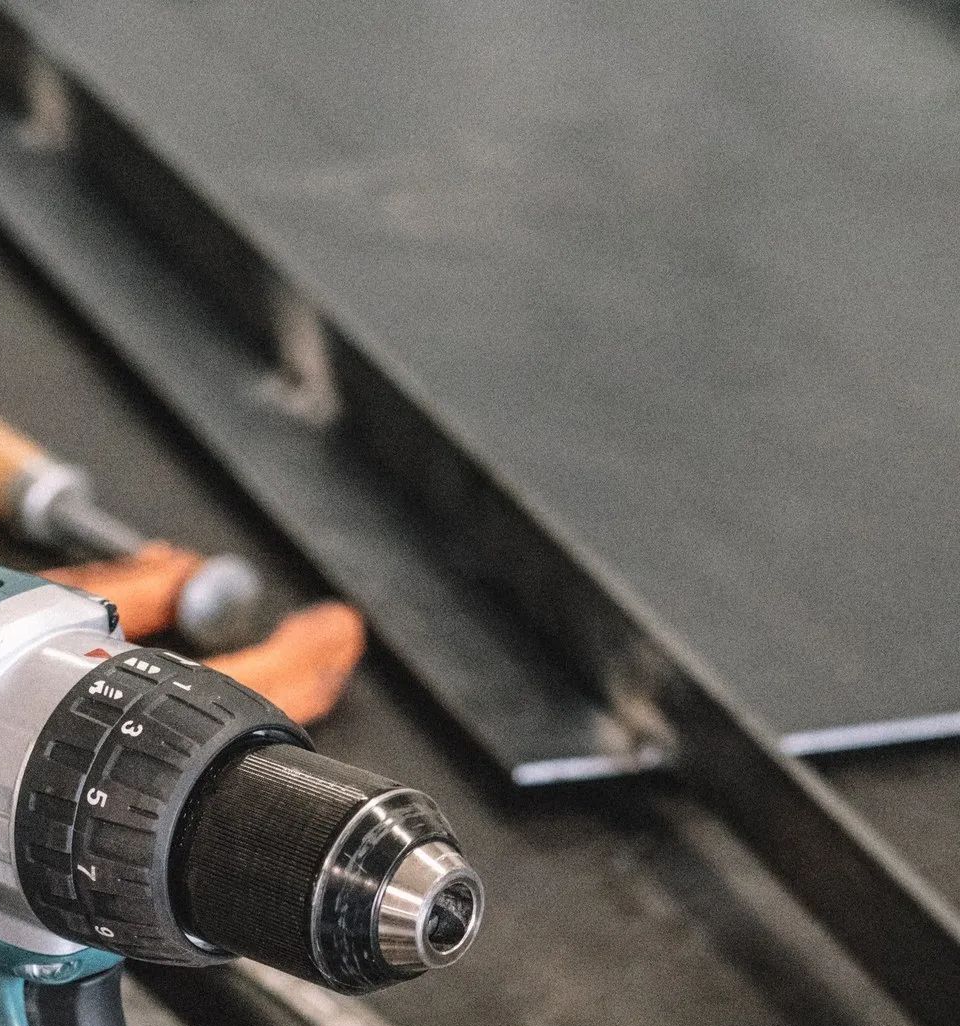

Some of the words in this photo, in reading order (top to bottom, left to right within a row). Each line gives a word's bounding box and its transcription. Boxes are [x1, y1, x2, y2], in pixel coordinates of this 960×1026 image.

[172, 680, 192, 691] 1
[120, 719, 144, 738] 3
[86, 787, 108, 808] 5
[76, 863, 97, 882] 7
